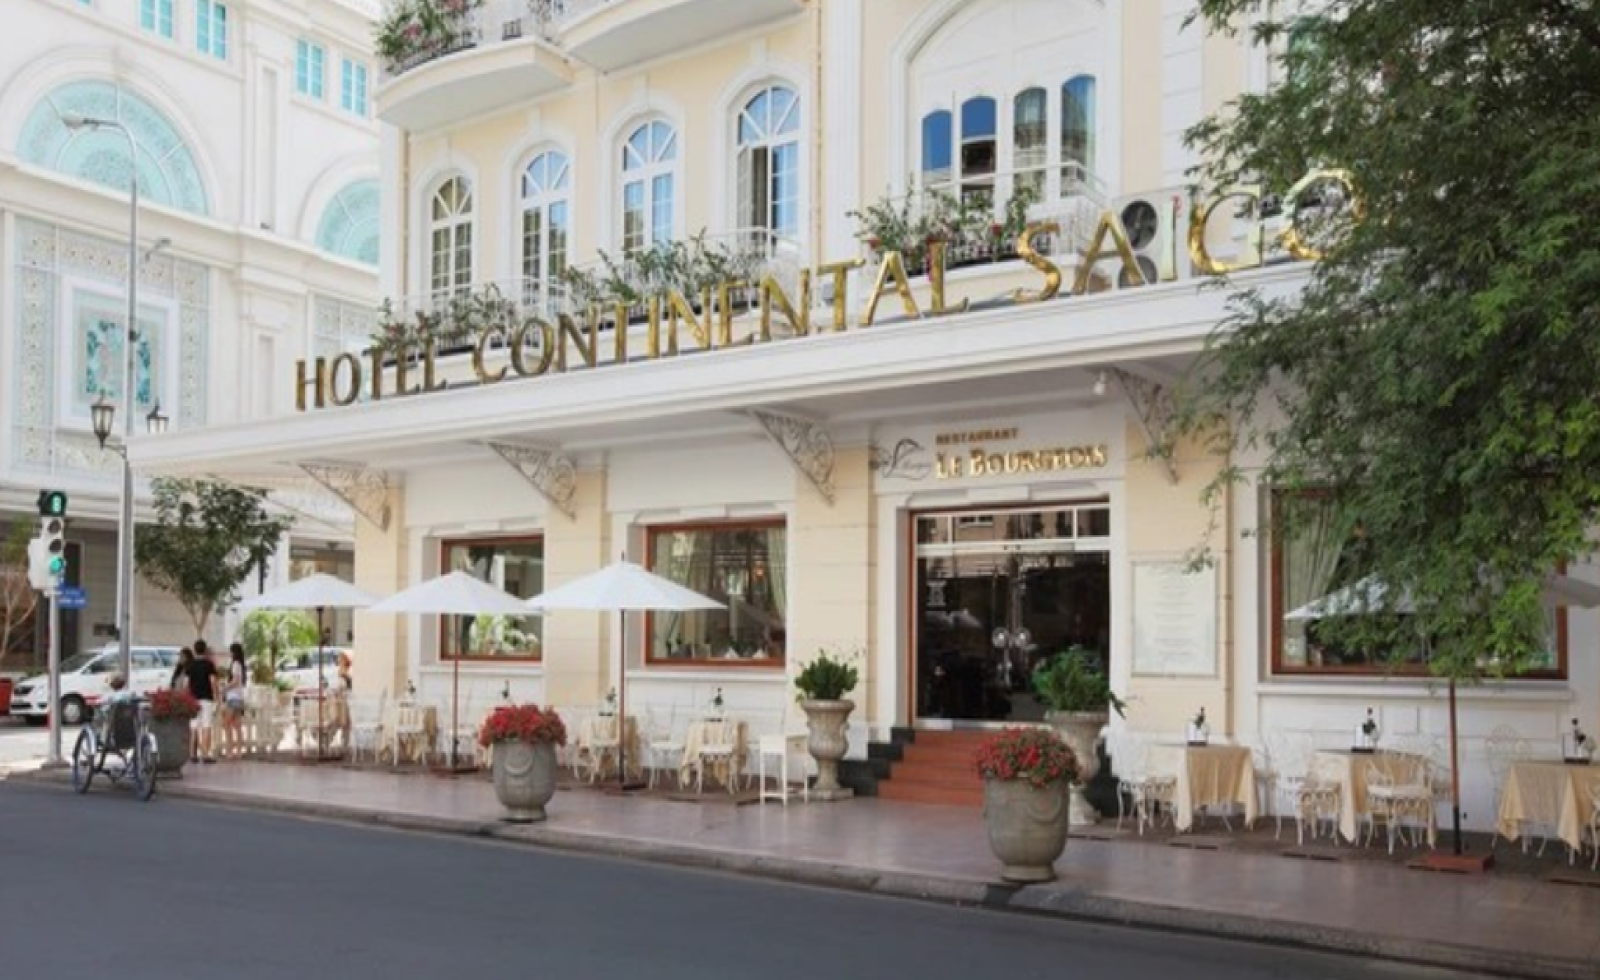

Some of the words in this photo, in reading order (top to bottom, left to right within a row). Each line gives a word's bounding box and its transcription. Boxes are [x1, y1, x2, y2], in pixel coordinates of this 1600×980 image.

[295, 338, 447, 411] HOTEL
[471, 240, 969, 384] CONTINENTAL
[936, 428, 1018, 445] RESTAURANT
